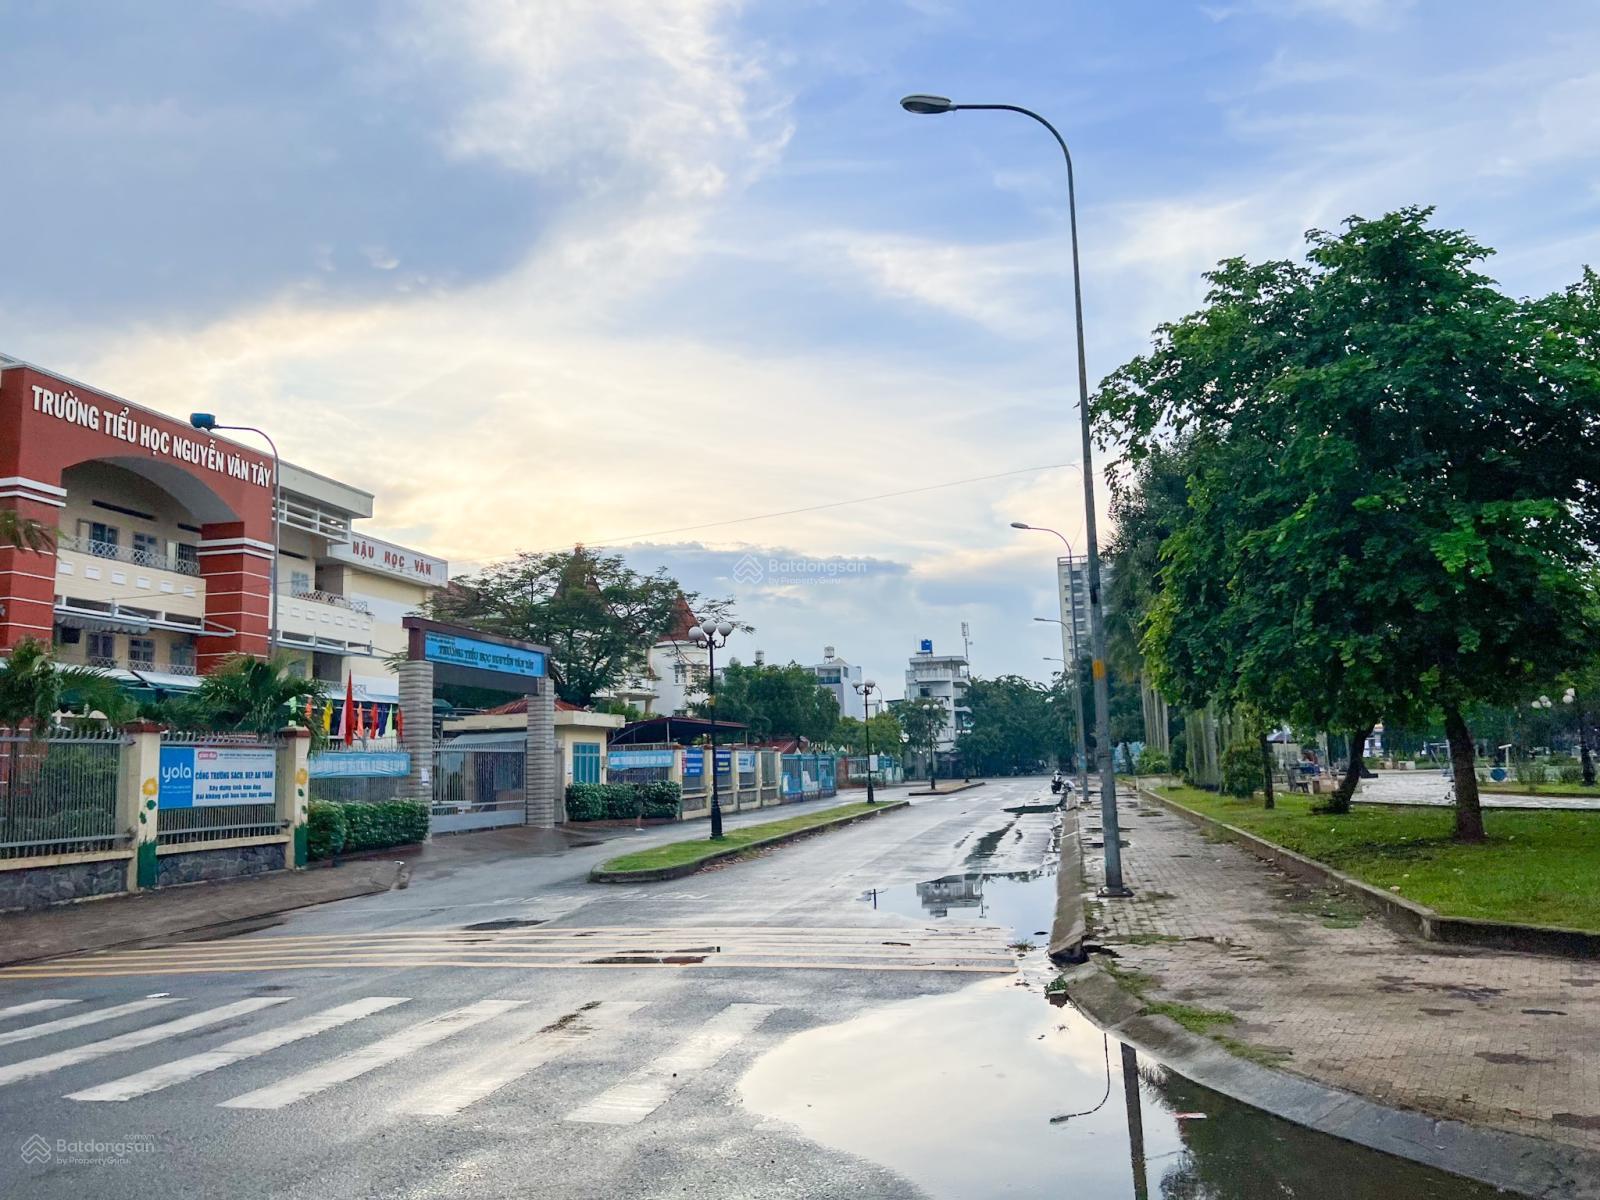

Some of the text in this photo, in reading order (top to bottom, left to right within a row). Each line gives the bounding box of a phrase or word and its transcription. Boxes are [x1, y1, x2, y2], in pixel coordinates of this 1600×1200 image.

[32, 385, 272, 487] TRƯỜNG TIỂU HỌC NGUYỄN VĂN TÂY
[384, 551, 405, 568] HỌC
[414, 558, 432, 576] VĂN
[162, 762, 192, 783] yola
